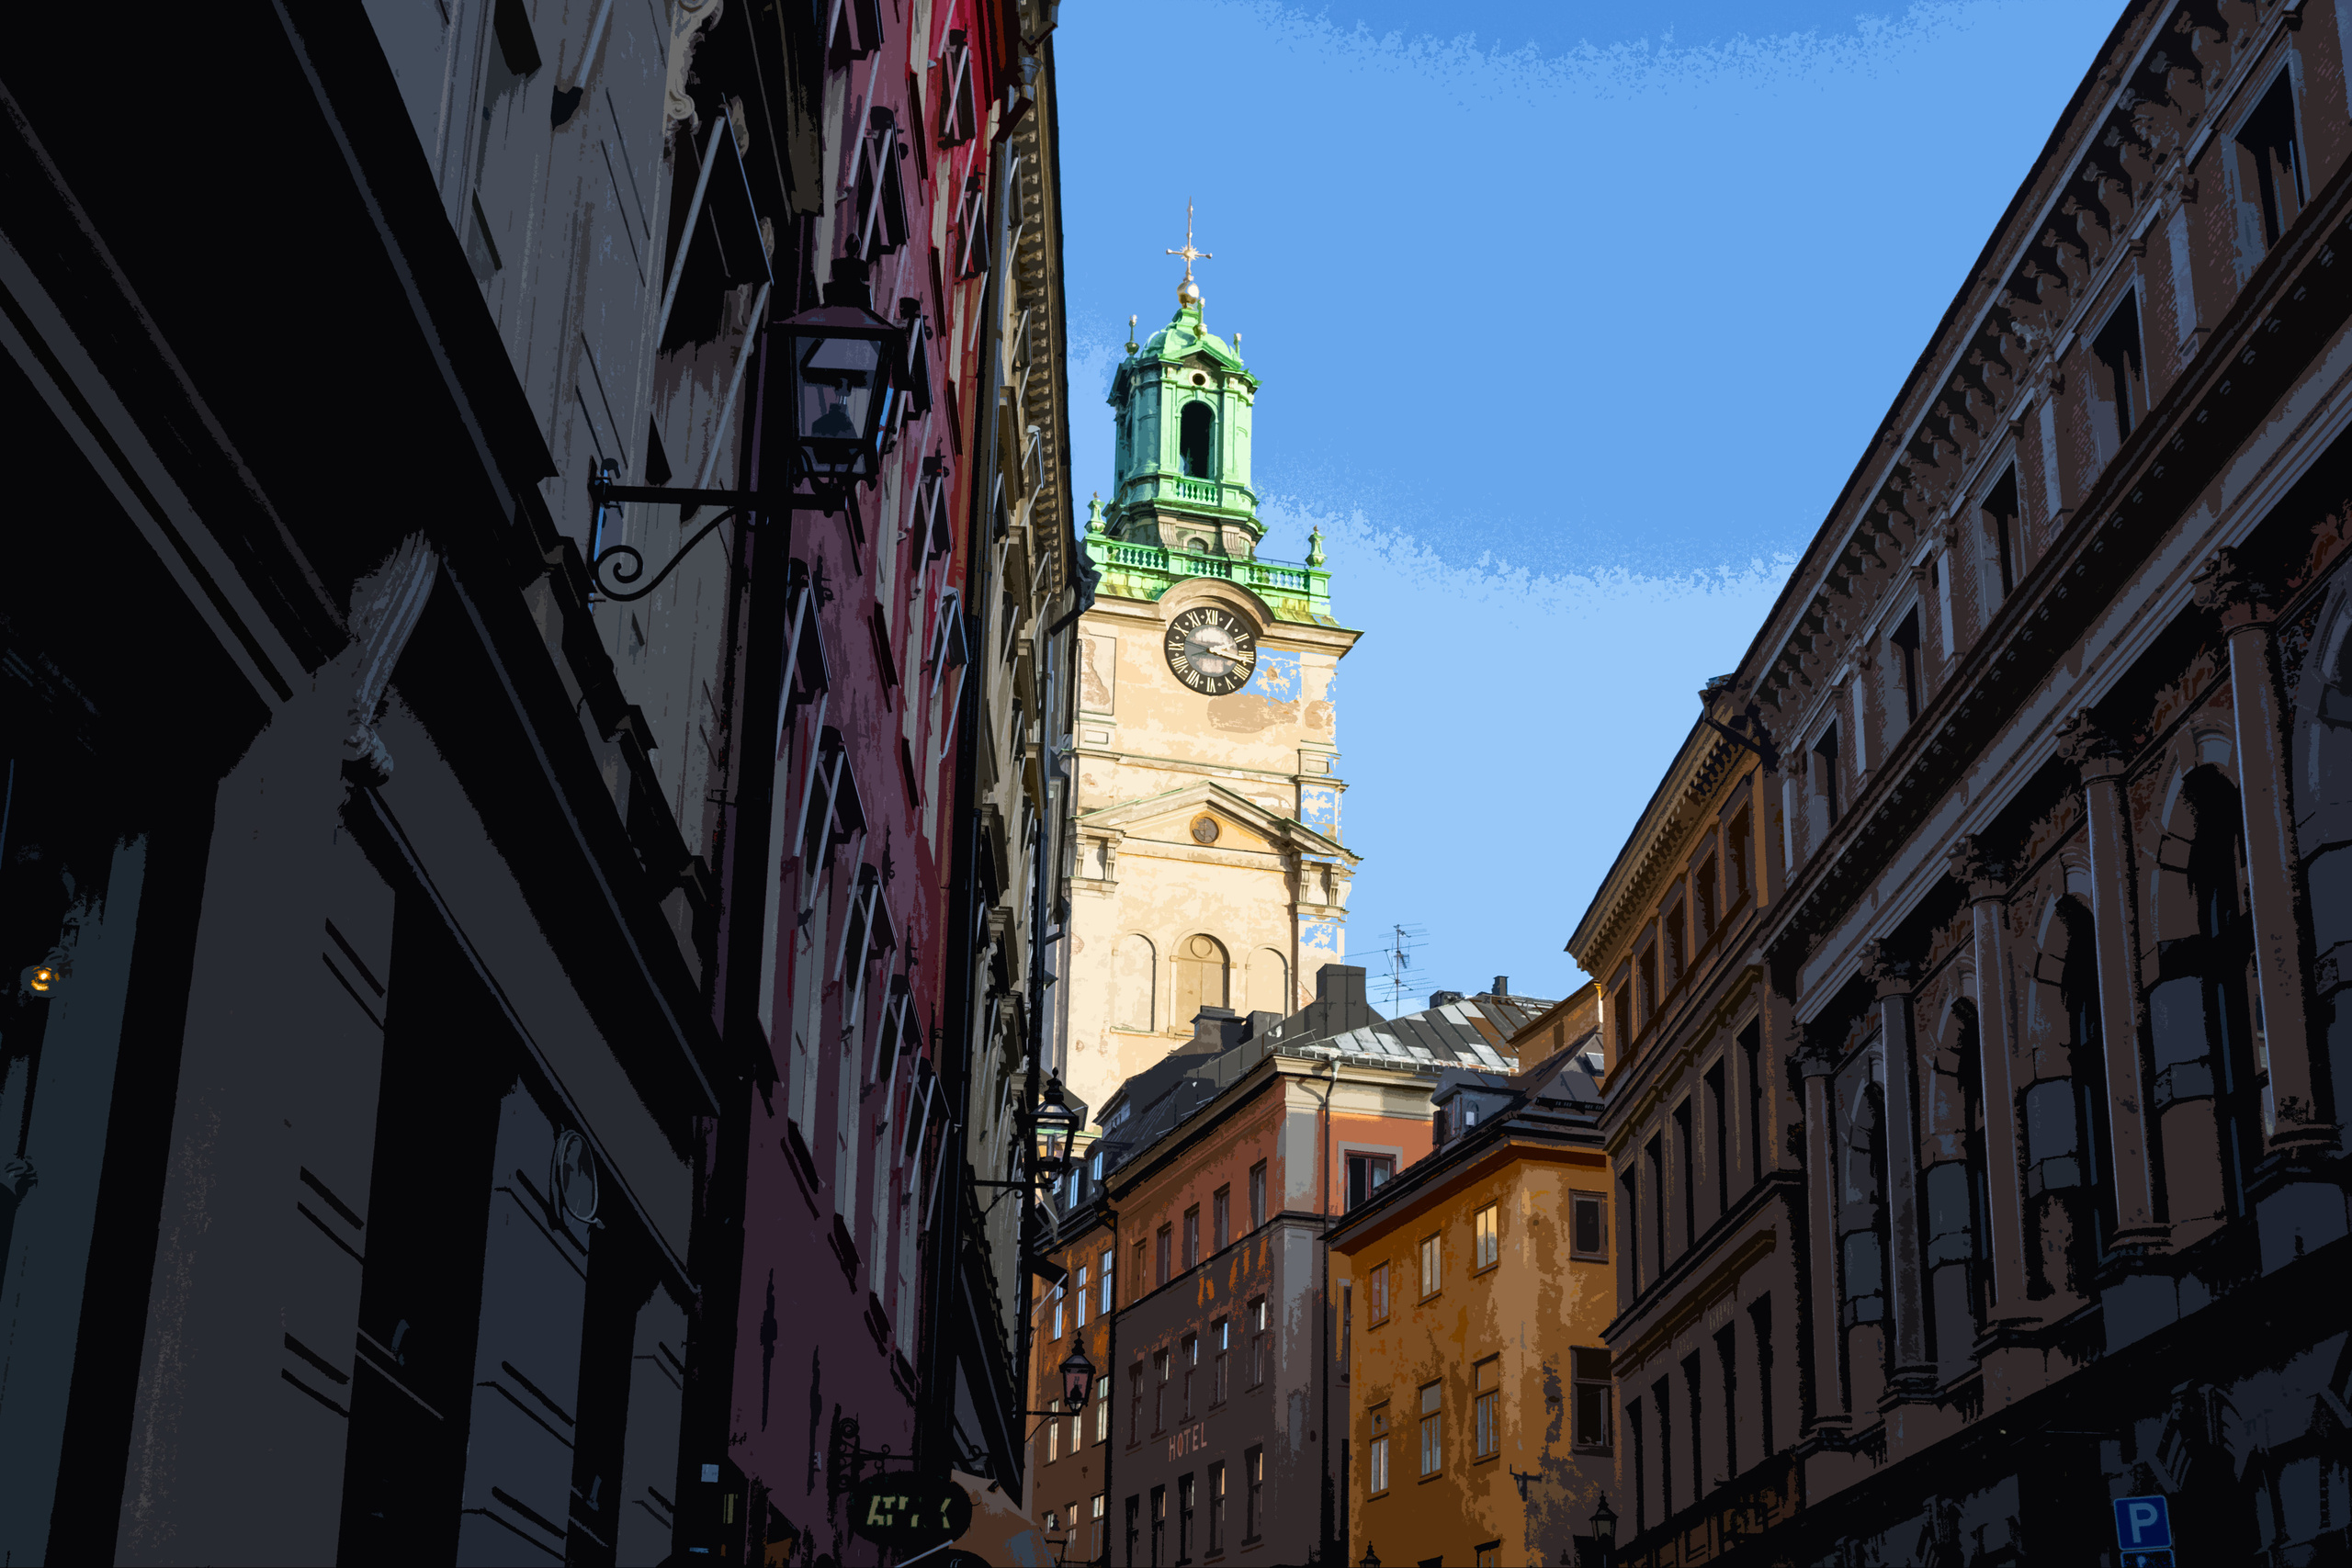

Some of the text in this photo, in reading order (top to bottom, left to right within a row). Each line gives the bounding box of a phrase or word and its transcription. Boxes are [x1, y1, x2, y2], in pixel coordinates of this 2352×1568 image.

[1186, 611, 1202, 628] XI
[1205, 609, 1218, 626] XII
[1224, 617, 1235, 631] I
[1173, 623, 1190, 637] X
[1234, 632, 1250, 643] II
[1168, 640, 1184, 651] IX
[1170, 655, 1190, 674] VIII
[1232, 663, 1250, 681] IIII
[1185, 670, 1201, 688] VII
[1206, 676, 1217, 693] VI
[1224, 676, 1236, 691] V
[1169, 1422, 1207, 1462] HOTEL
[2129, 1502, 2158, 1543] P
